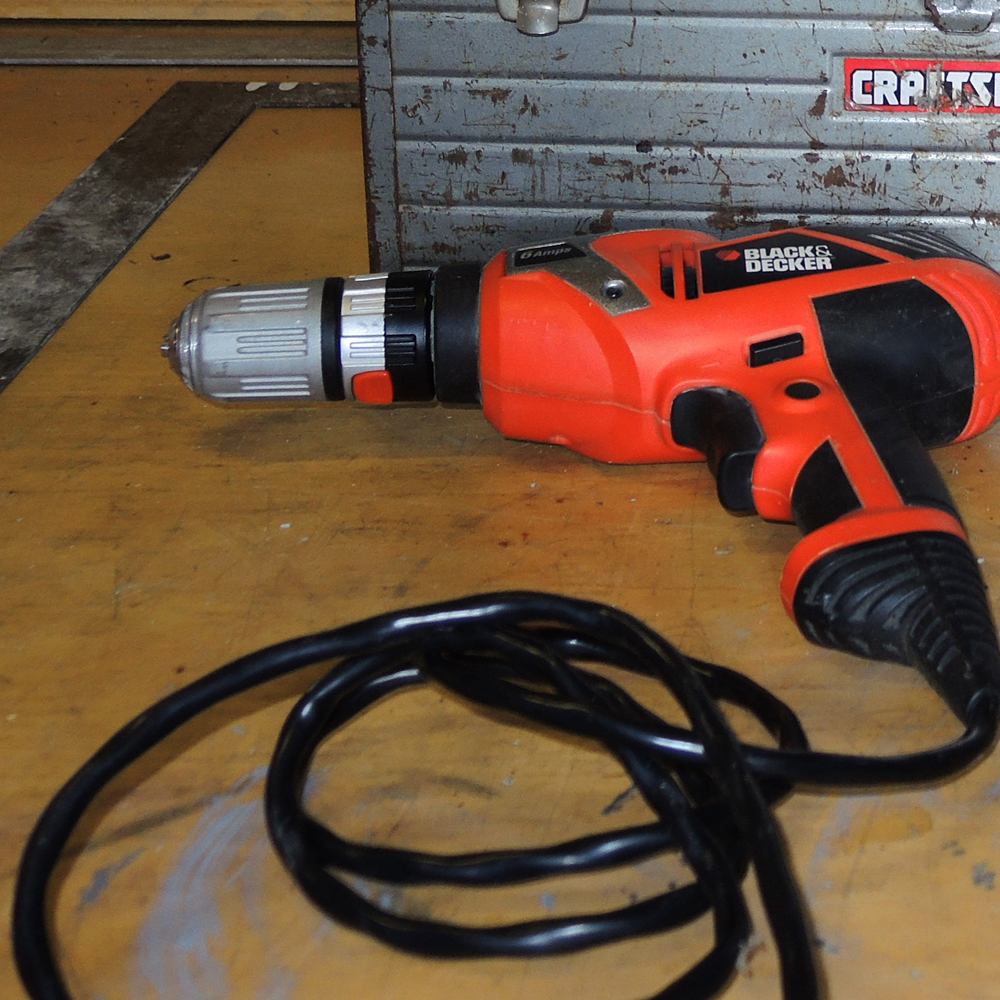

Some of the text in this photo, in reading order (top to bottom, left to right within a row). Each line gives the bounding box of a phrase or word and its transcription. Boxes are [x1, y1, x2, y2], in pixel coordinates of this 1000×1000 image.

[520, 247, 573, 260] 6 Amps
[745, 257, 833, 273] DECKER
